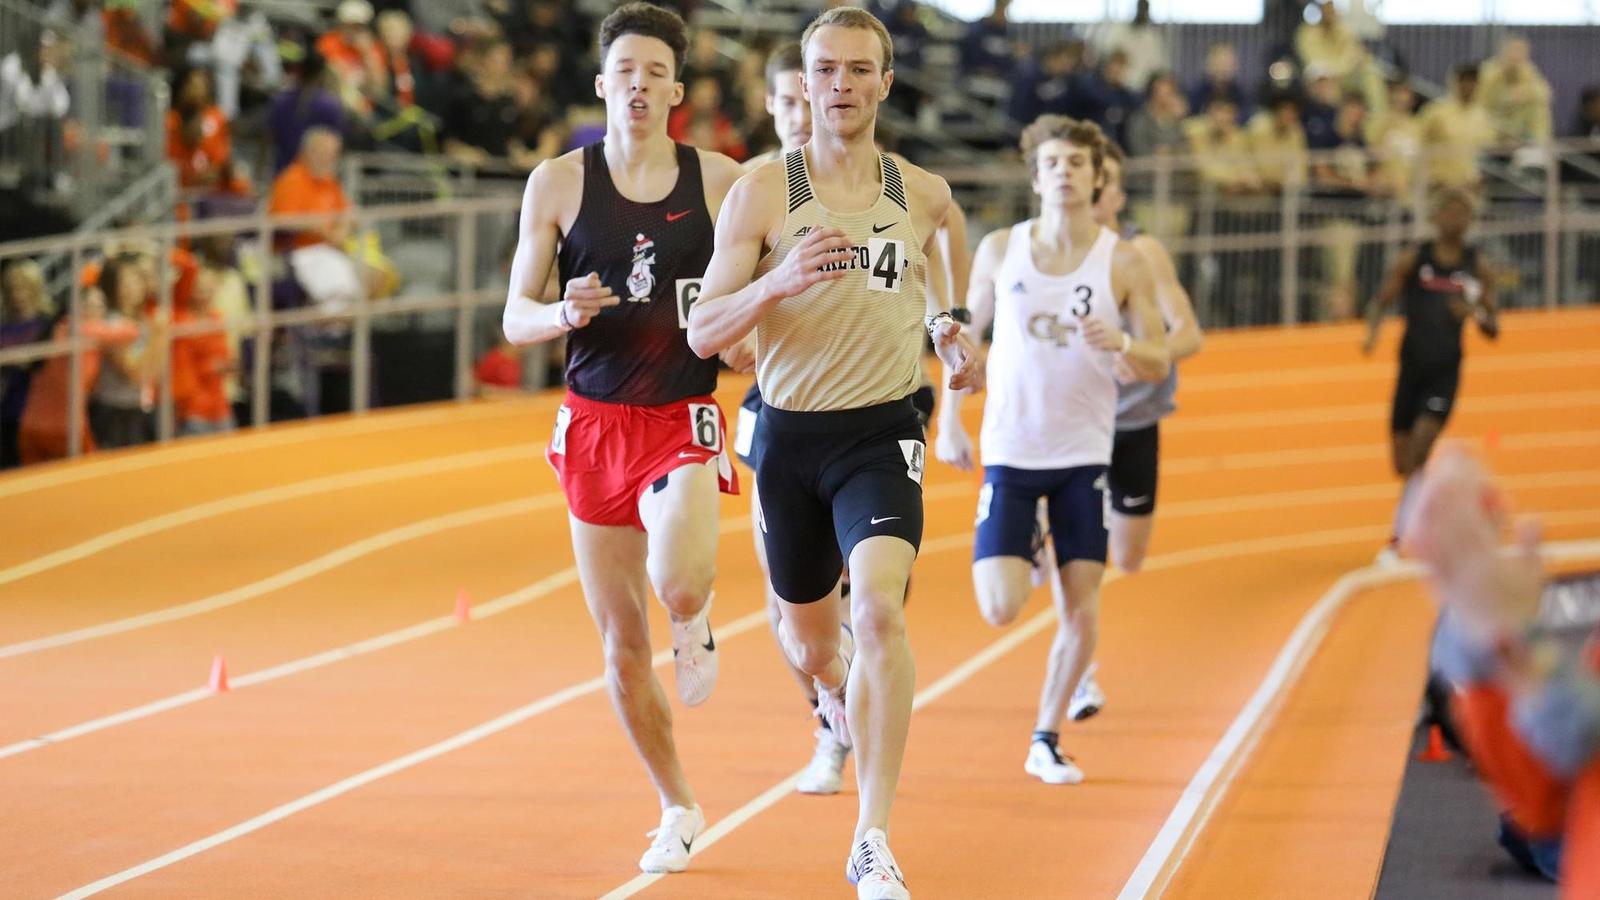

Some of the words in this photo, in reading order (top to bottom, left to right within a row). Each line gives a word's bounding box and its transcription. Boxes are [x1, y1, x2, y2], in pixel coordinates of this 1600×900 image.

[873, 242, 898, 289] 4
[1072, 285, 1092, 318] 3
[696, 407, 716, 447] 6
